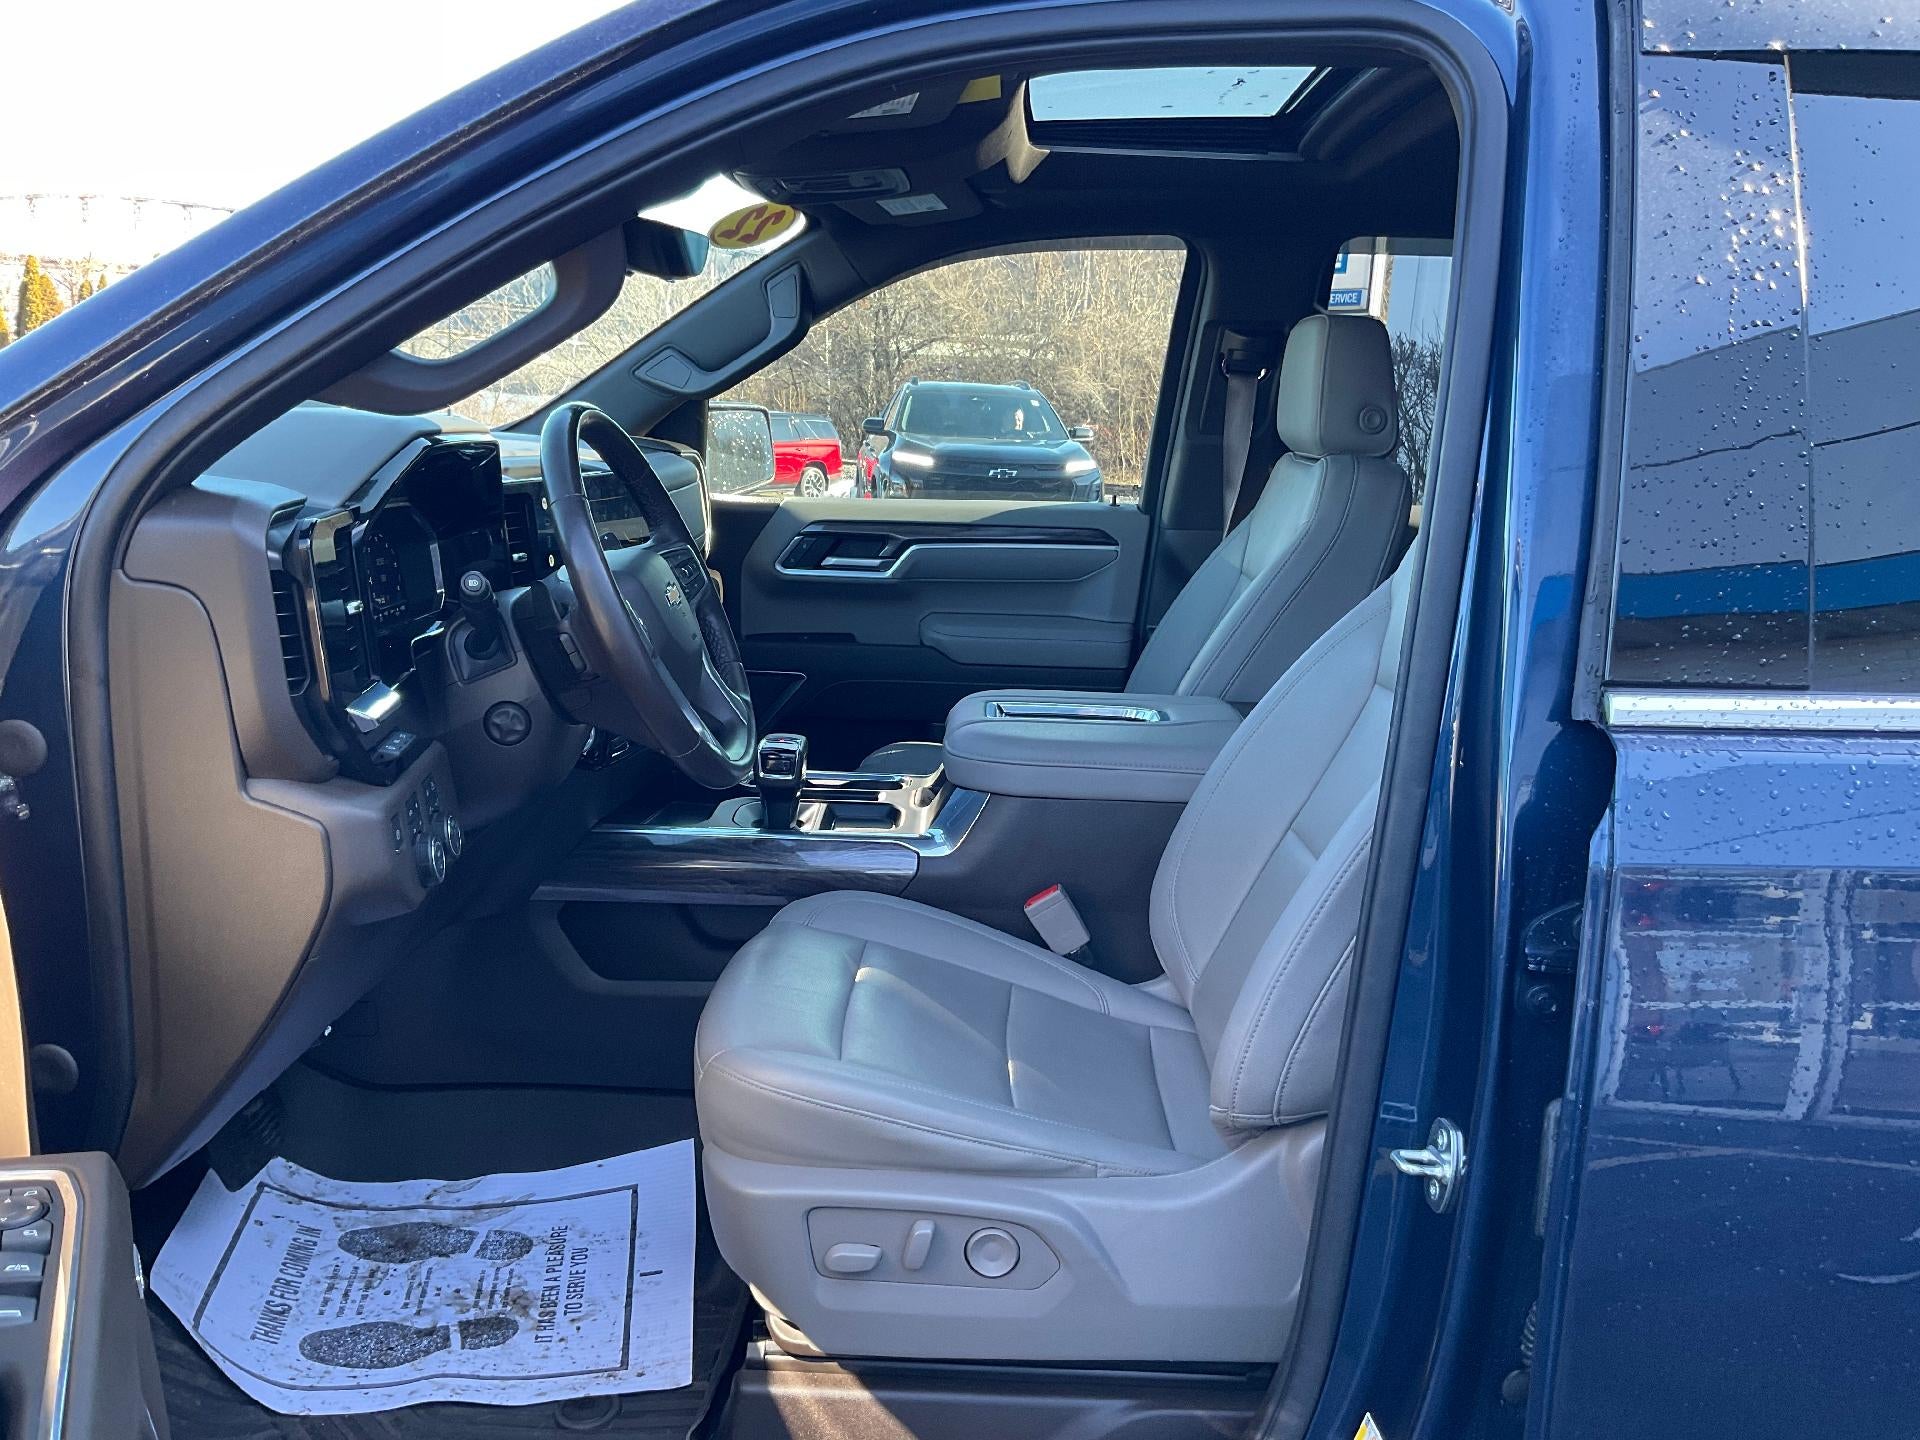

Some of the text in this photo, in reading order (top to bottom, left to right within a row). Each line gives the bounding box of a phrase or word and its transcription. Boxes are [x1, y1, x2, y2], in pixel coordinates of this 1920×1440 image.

[1330, 292, 1358, 304] ERVICE
[545, 1225, 568, 1273] PLEASURE
[250, 1225, 323, 1344] THANKS FOR COMING IN
[563, 1247, 589, 1316] TO SERVE YOU
[540, 1283, 561, 1308] BEEN
[535, 1308, 557, 1331] HAS
[534, 1334, 553, 1343] IT
